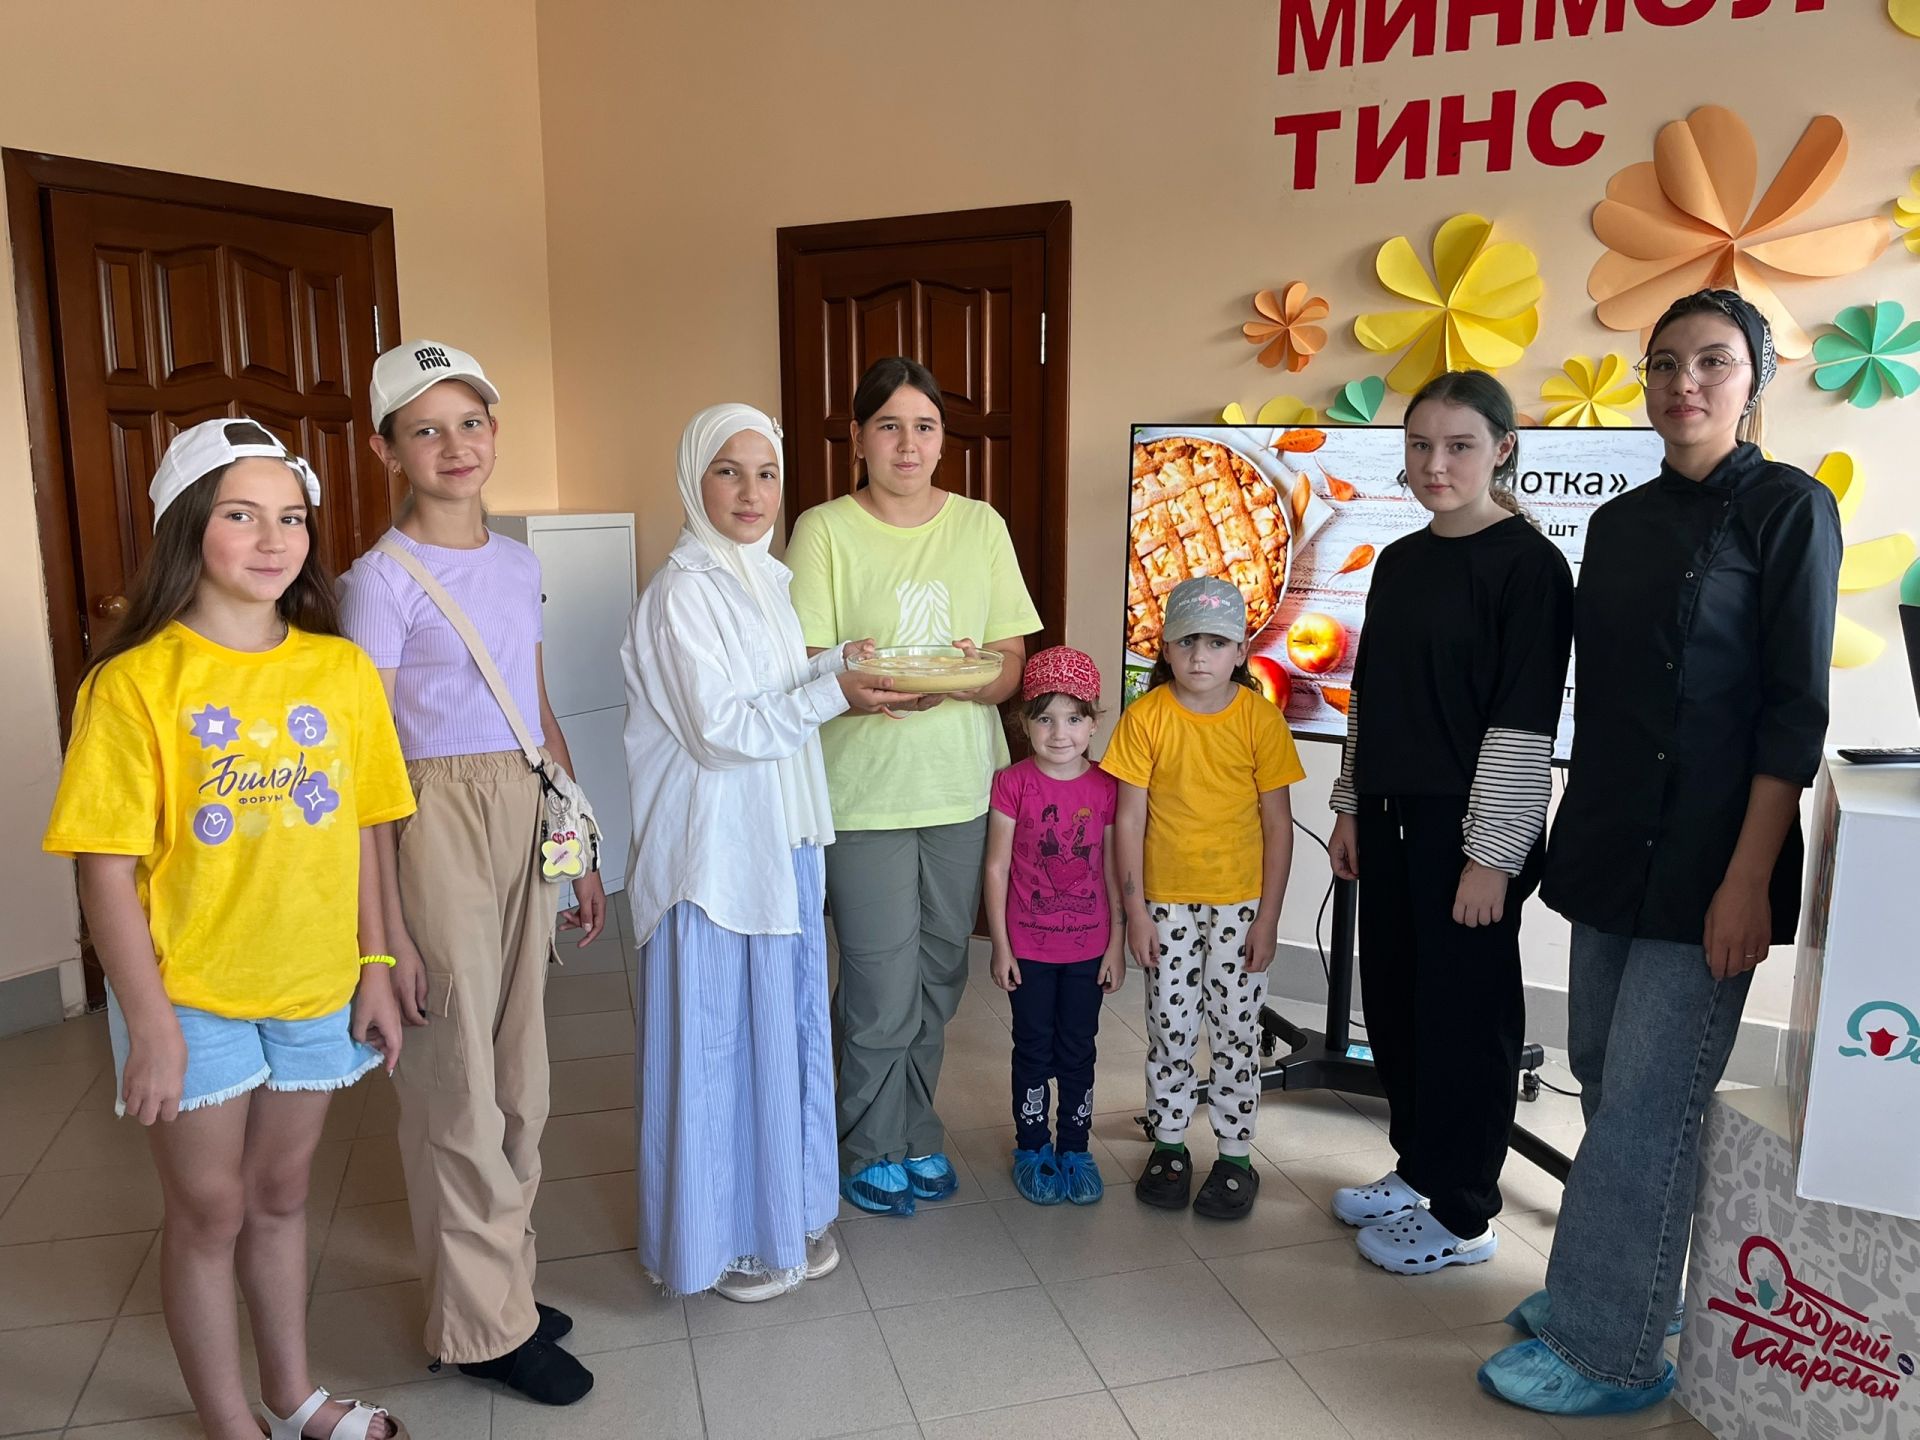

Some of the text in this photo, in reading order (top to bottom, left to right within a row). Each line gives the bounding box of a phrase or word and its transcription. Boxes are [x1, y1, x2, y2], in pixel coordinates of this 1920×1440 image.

[1274, 81, 1608, 190] ТИНС
[1548, 524, 1578, 537] шт
[238, 794, 284, 805] ФОРУМ
